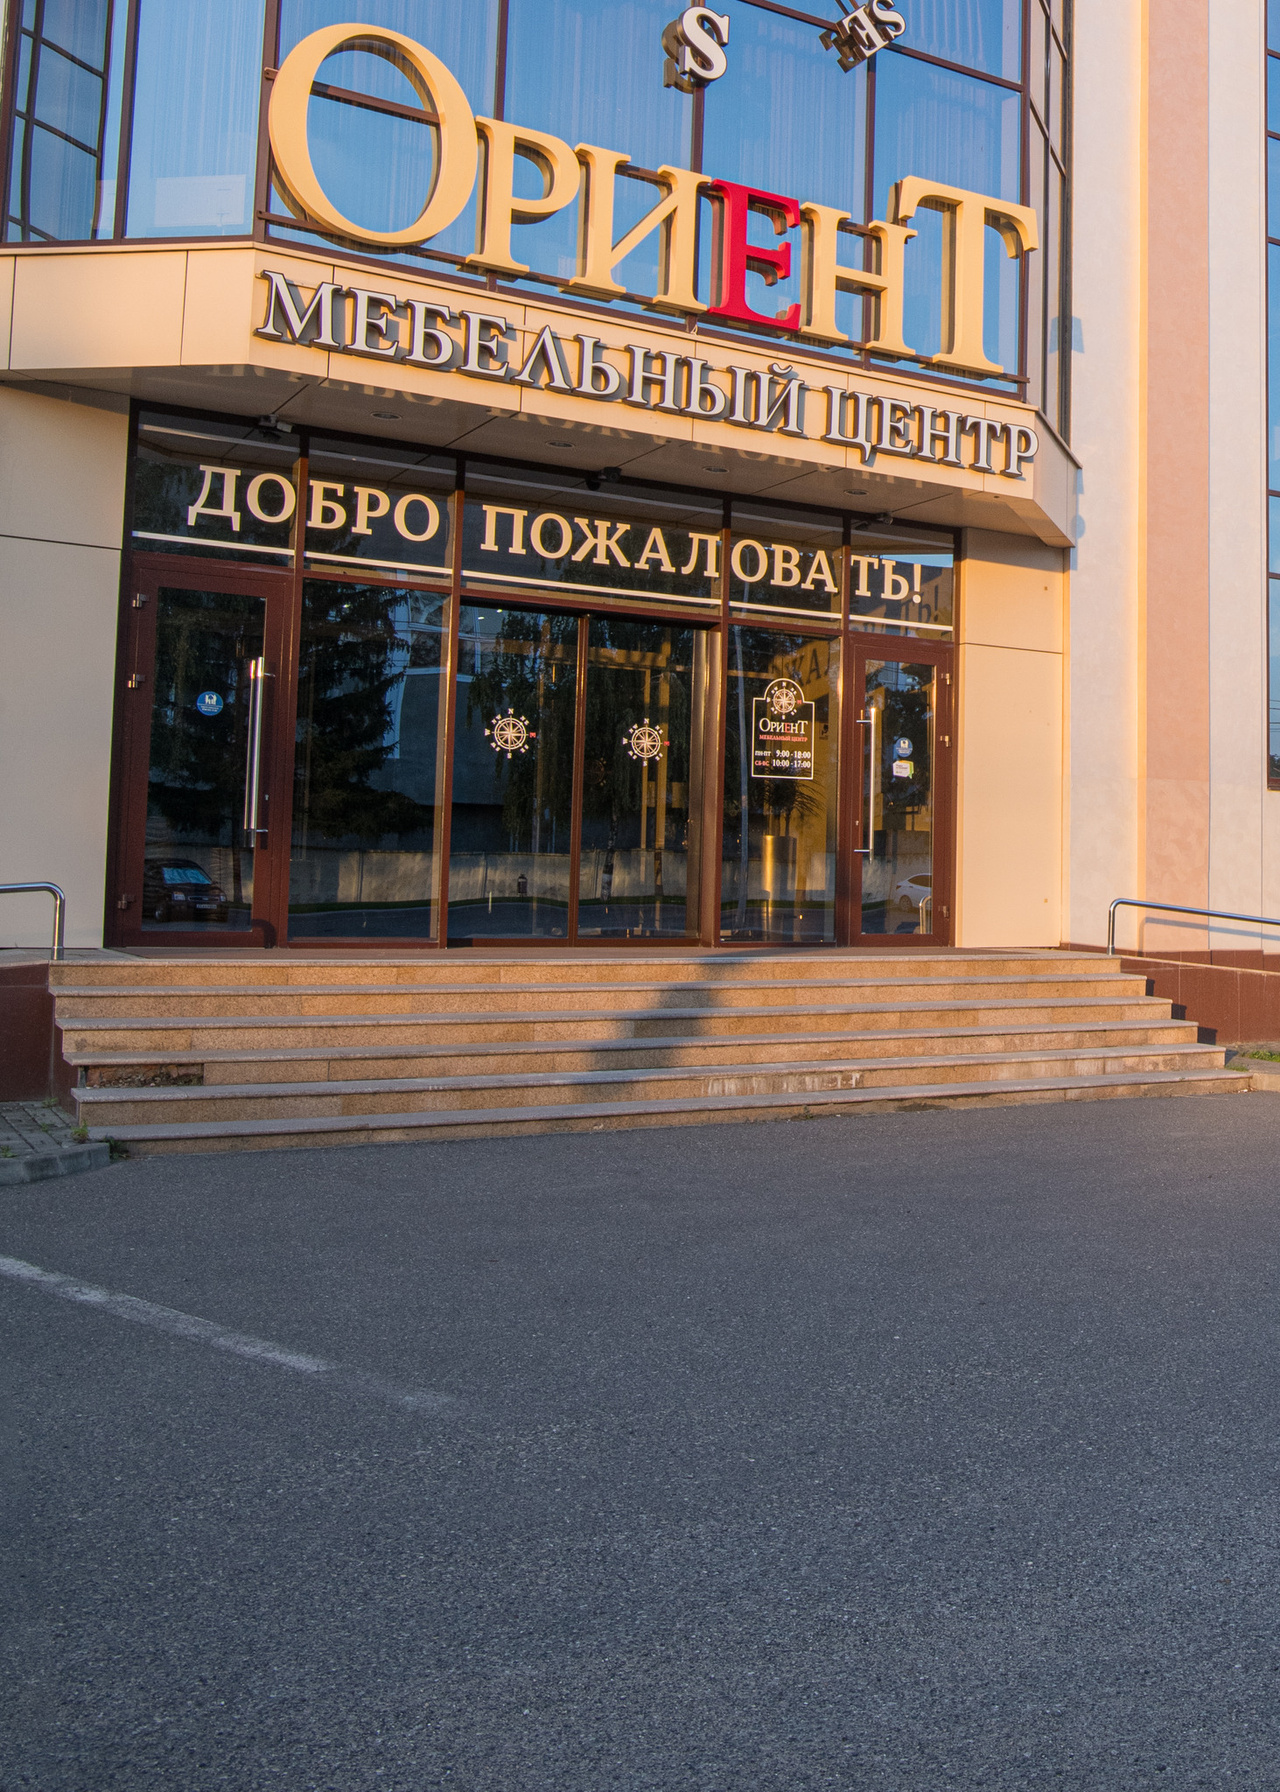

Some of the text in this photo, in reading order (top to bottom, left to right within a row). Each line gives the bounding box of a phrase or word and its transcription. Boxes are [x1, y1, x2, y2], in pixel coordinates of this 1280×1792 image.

[678, 5, 729, 83] S
[268, 22, 1039, 379] ОРИЕНТ
[254, 269, 1040, 478] МЕБЕЛЬНЫЙ ЦЕНТР
[188, 465, 924, 605] ДОБРО ПОЖАЛОВАТЬ!
[759, 718, 808, 734] ОРИЕНТ
[772, 759, 790, 767] 10:00
[794, 760, 811, 768] 17:00
[776, 750, 790, 758] 9:00
[794, 751, 811, 759] 18:00
